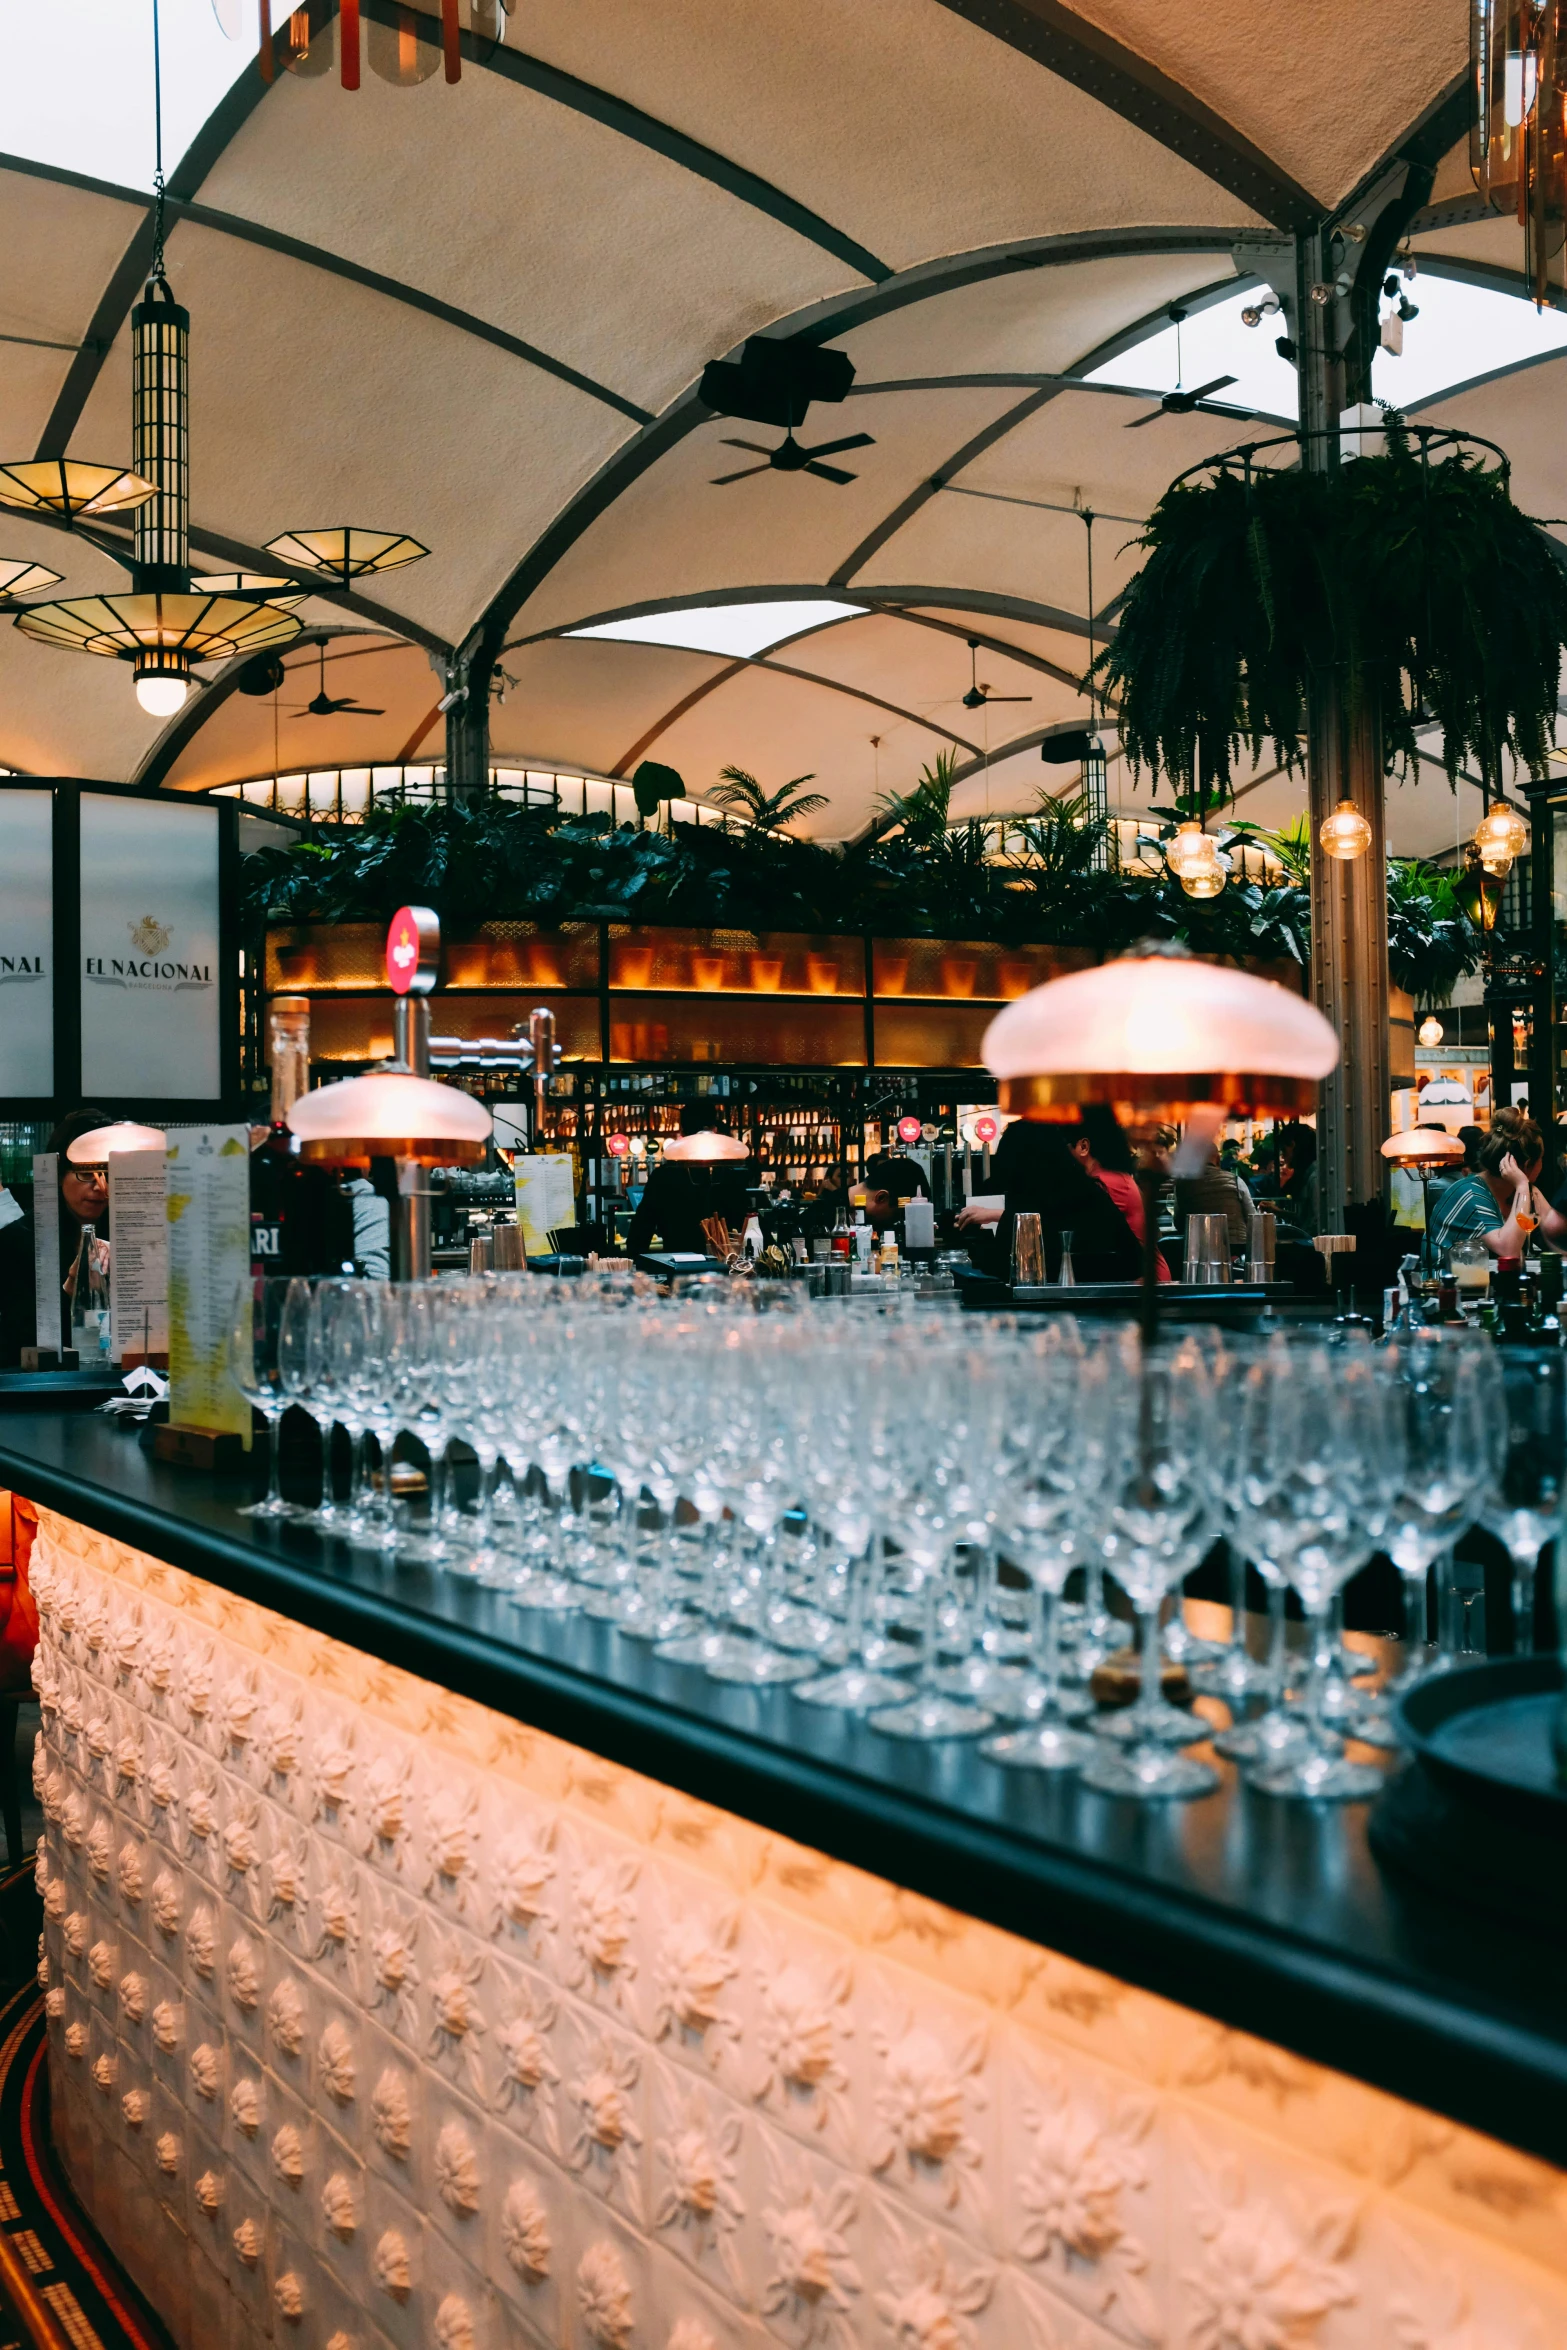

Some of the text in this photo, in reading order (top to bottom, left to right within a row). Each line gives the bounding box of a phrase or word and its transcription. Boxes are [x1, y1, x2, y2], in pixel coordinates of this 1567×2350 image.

[0, 956, 45, 973] NAL
[86, 957, 213, 982] EL NACIONAL
[250, 1227, 280, 1255] RI
